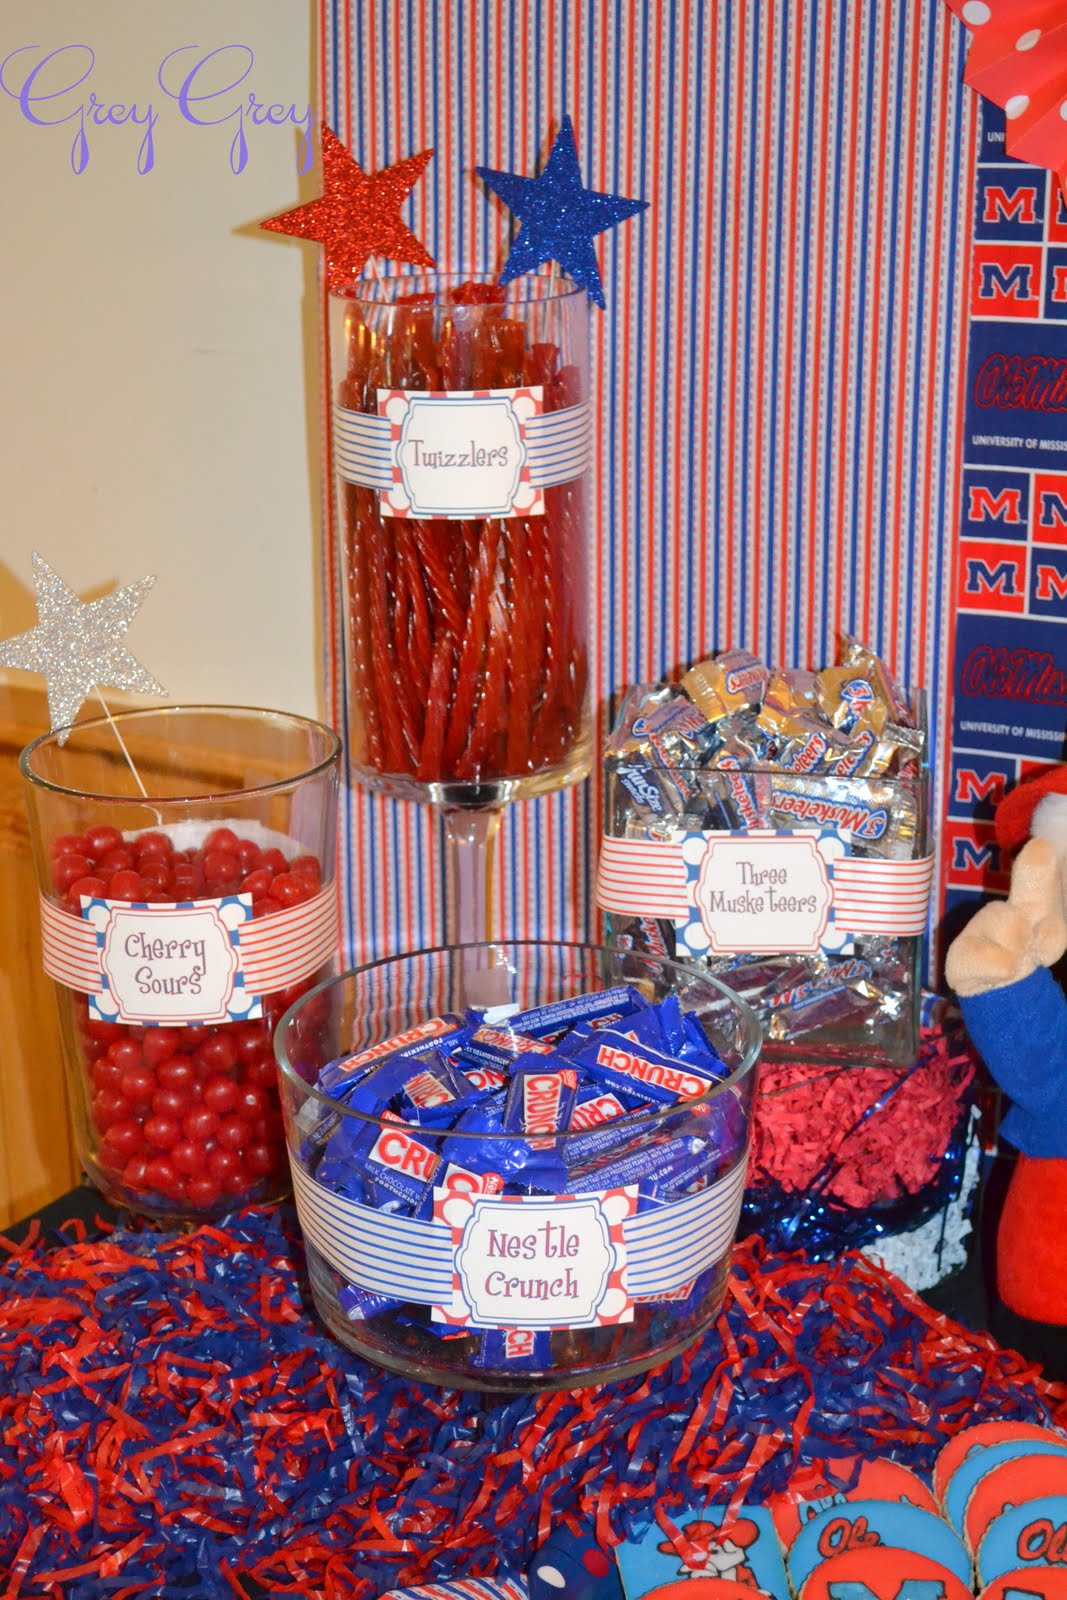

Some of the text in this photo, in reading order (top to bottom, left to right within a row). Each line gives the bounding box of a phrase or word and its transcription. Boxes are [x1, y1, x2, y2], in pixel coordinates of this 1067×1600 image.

[984, 186, 1037, 223] M
[979, 262, 1033, 299] M
[407, 438, 508, 469] Twizzlers
[972, 435, 1024, 448] UNIVERSITY
[1025, 437, 1038, 449] OF
[968, 486, 1021, 524] M
[965, 558, 1019, 597] M
[960, 720, 1011, 735] UNIVERSITY
[1011, 726, 1025, 737] OF
[772, 793, 870, 833] Musketeers
[735, 861, 788, 886] Three
[124, 932, 206, 976] Cherry
[134, 965, 202, 995] Sours
[339, 1018, 445, 1072] CRUNCH
[599, 1046, 706, 1099] CRUNCH
[526, 1075, 561, 1150] CRUNCH
[378, 1170, 416, 1197] CHOCOLATE
[484, 1267, 580, 1301] Crunch
